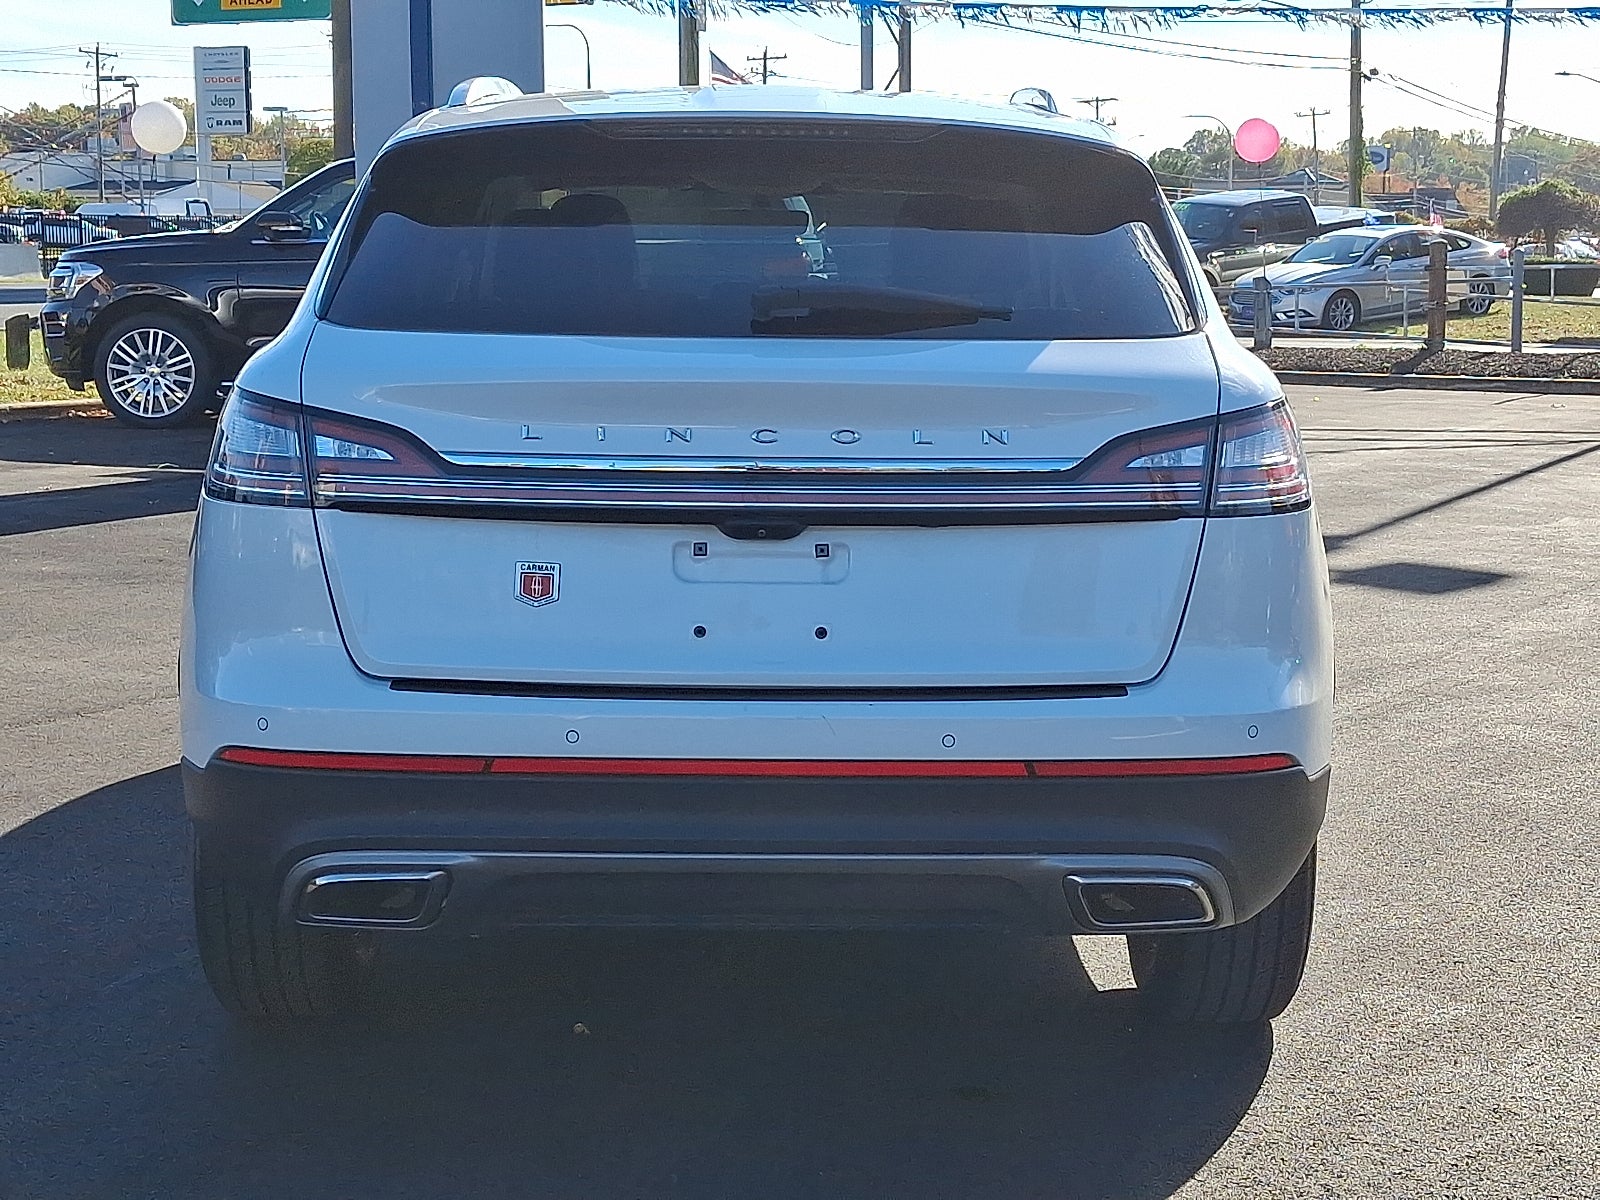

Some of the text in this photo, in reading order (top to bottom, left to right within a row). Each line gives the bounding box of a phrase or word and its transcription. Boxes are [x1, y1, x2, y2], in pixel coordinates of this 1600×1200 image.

[210, 94, 236, 109] Jeep
[520, 424, 1009, 446] LINCOLN
[520, 563, 556, 572] CARMAN
